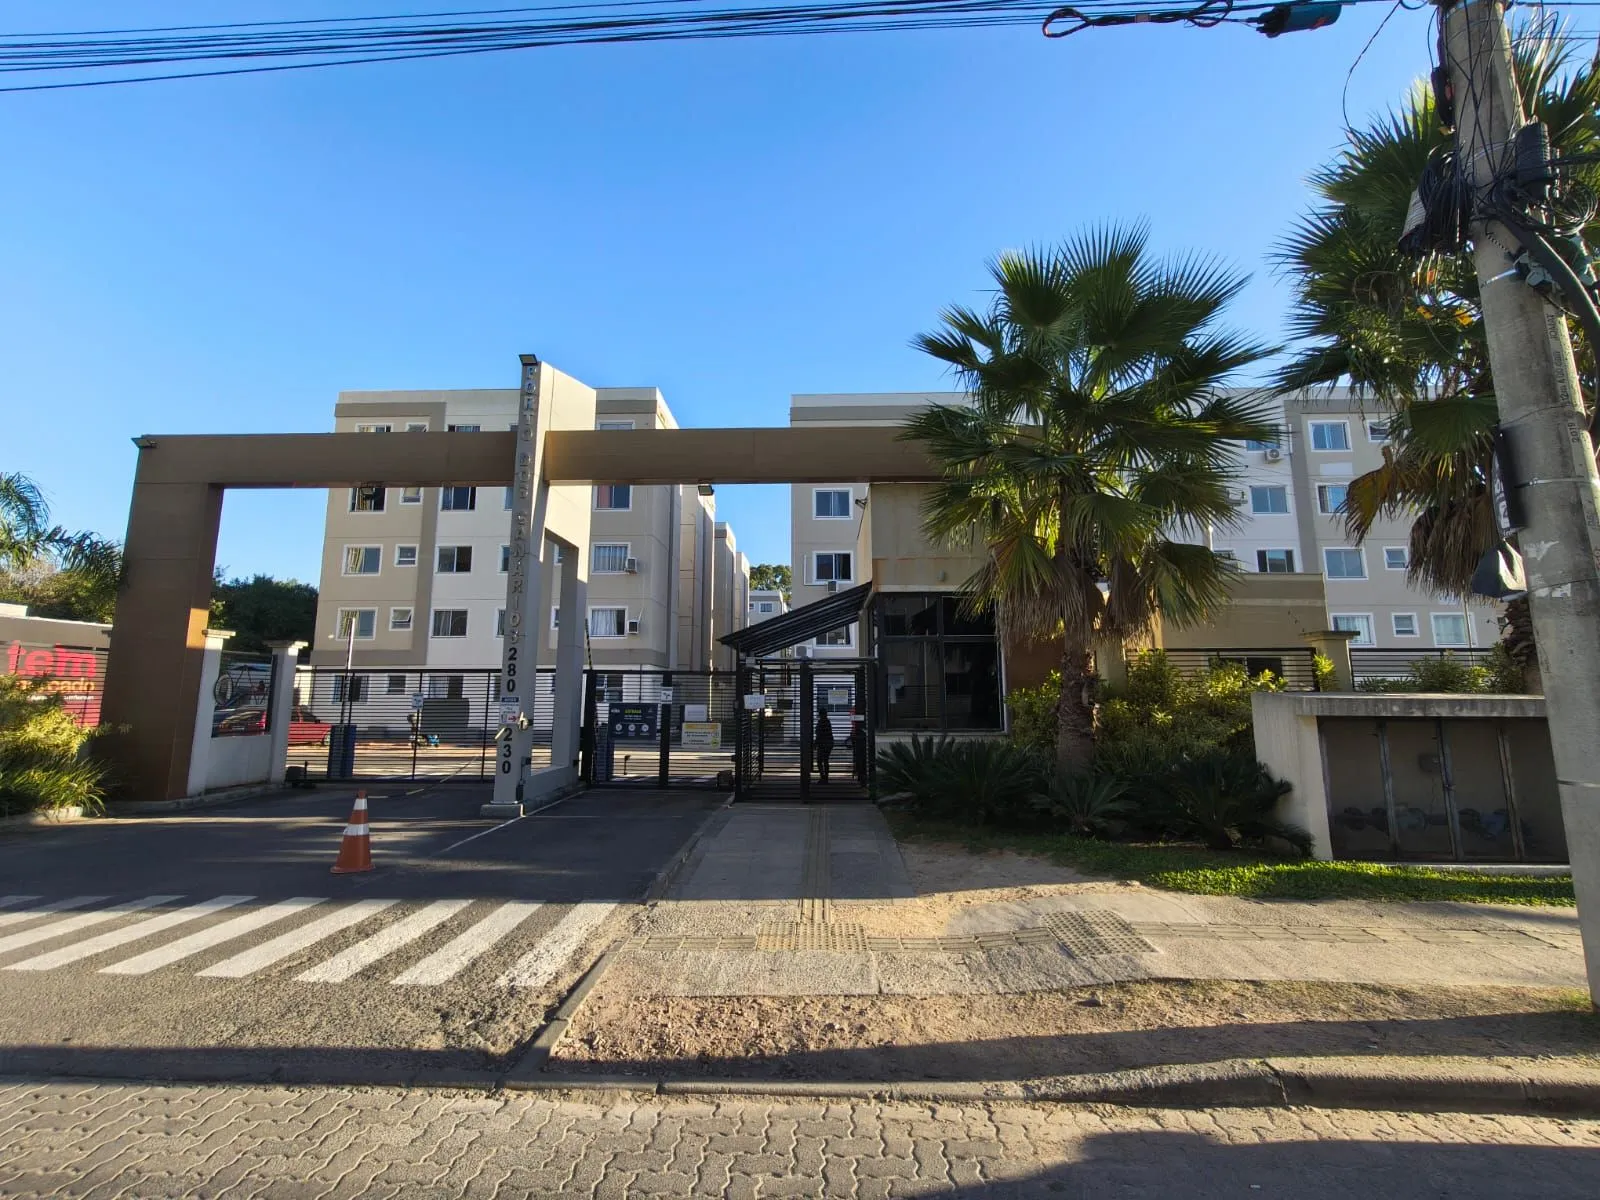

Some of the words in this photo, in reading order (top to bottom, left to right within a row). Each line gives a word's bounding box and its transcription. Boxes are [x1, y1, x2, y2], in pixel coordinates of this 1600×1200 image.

[521, 365, 537, 442] PORTO
[1567, 423, 1580, 443] 2019
[518, 452, 531, 499] DOS
[506, 647, 518, 692] 280
[501, 727, 513, 774] 230
